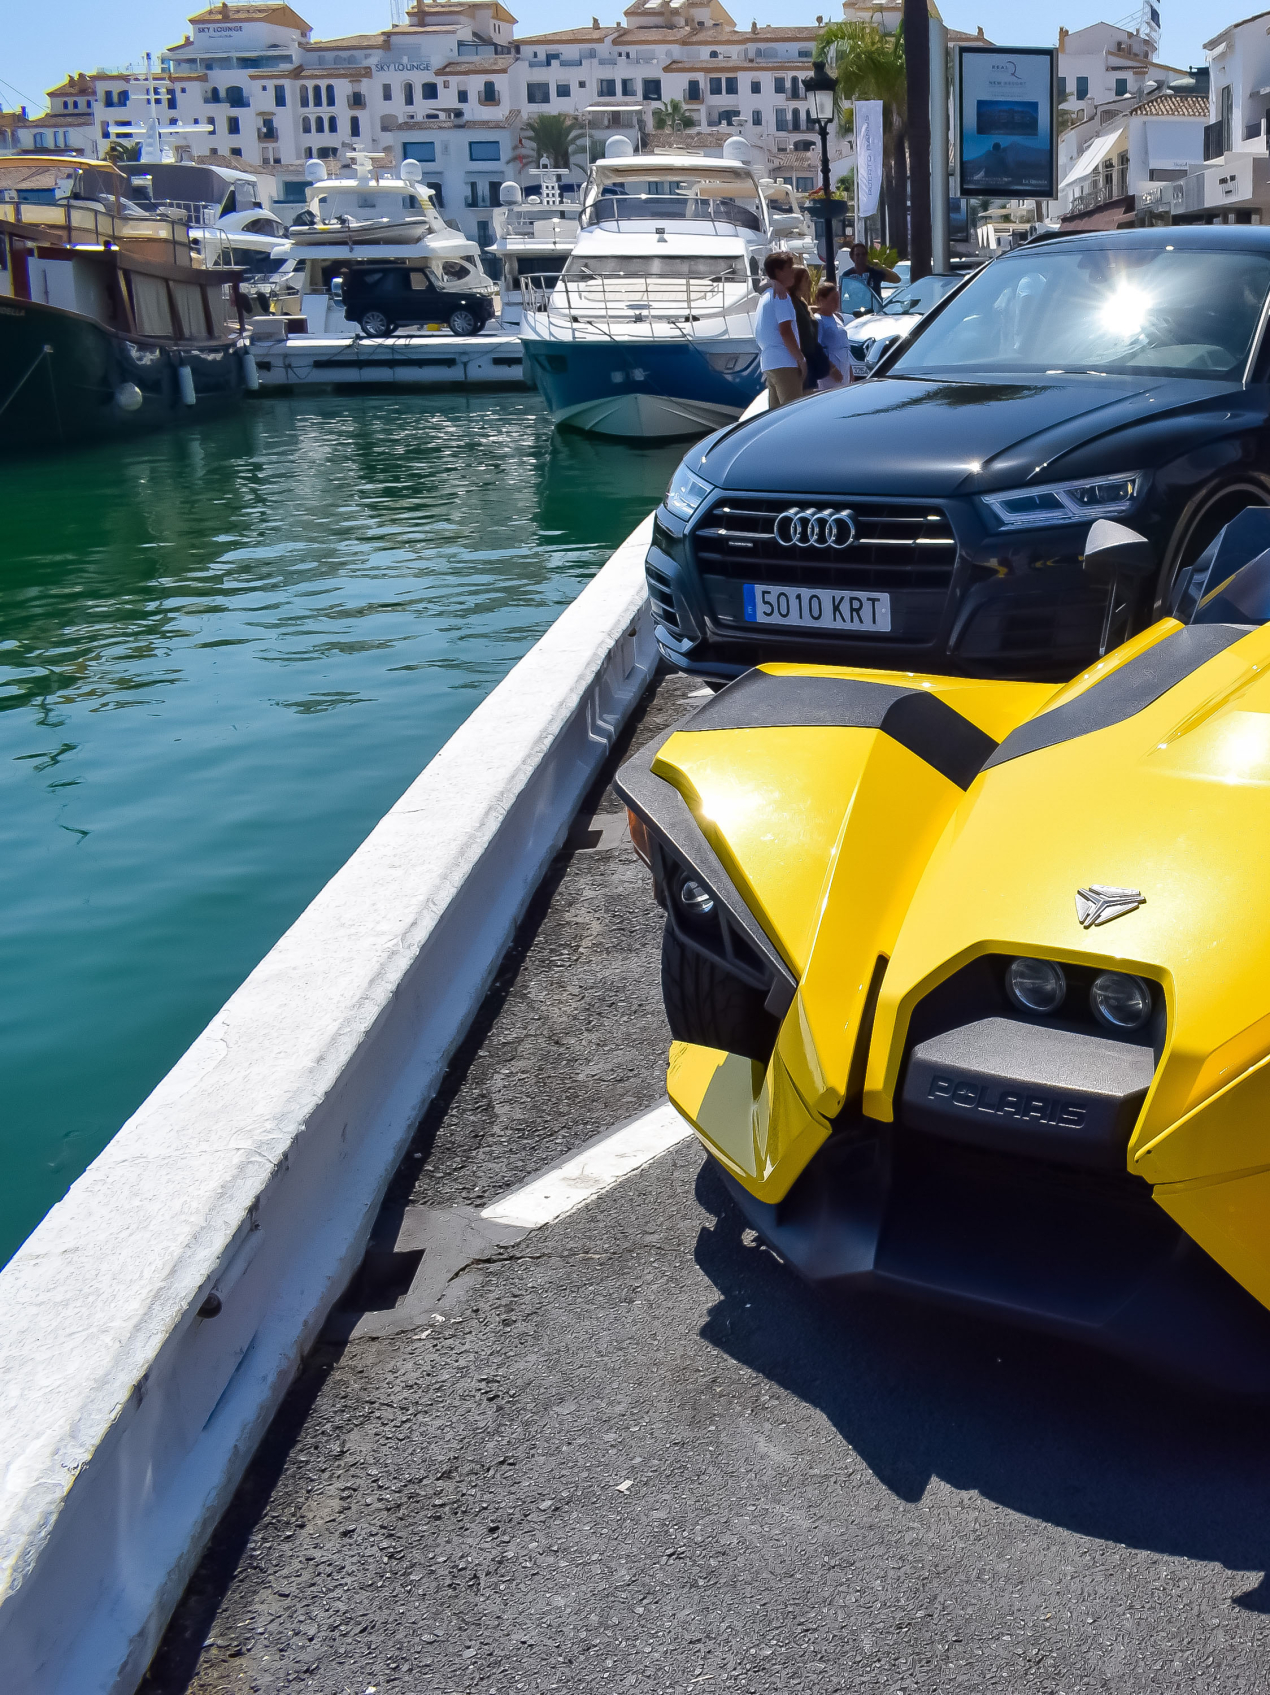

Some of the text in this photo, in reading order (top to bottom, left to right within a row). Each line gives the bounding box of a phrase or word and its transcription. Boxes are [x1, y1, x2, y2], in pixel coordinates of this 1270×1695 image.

[213, 25, 243, 33] LOUNGE
[375, 62, 431, 72] SKY LOUNGE
[761, 590, 881, 625] 5010 KRT
[927, 1074, 1088, 1129] POLARIS
